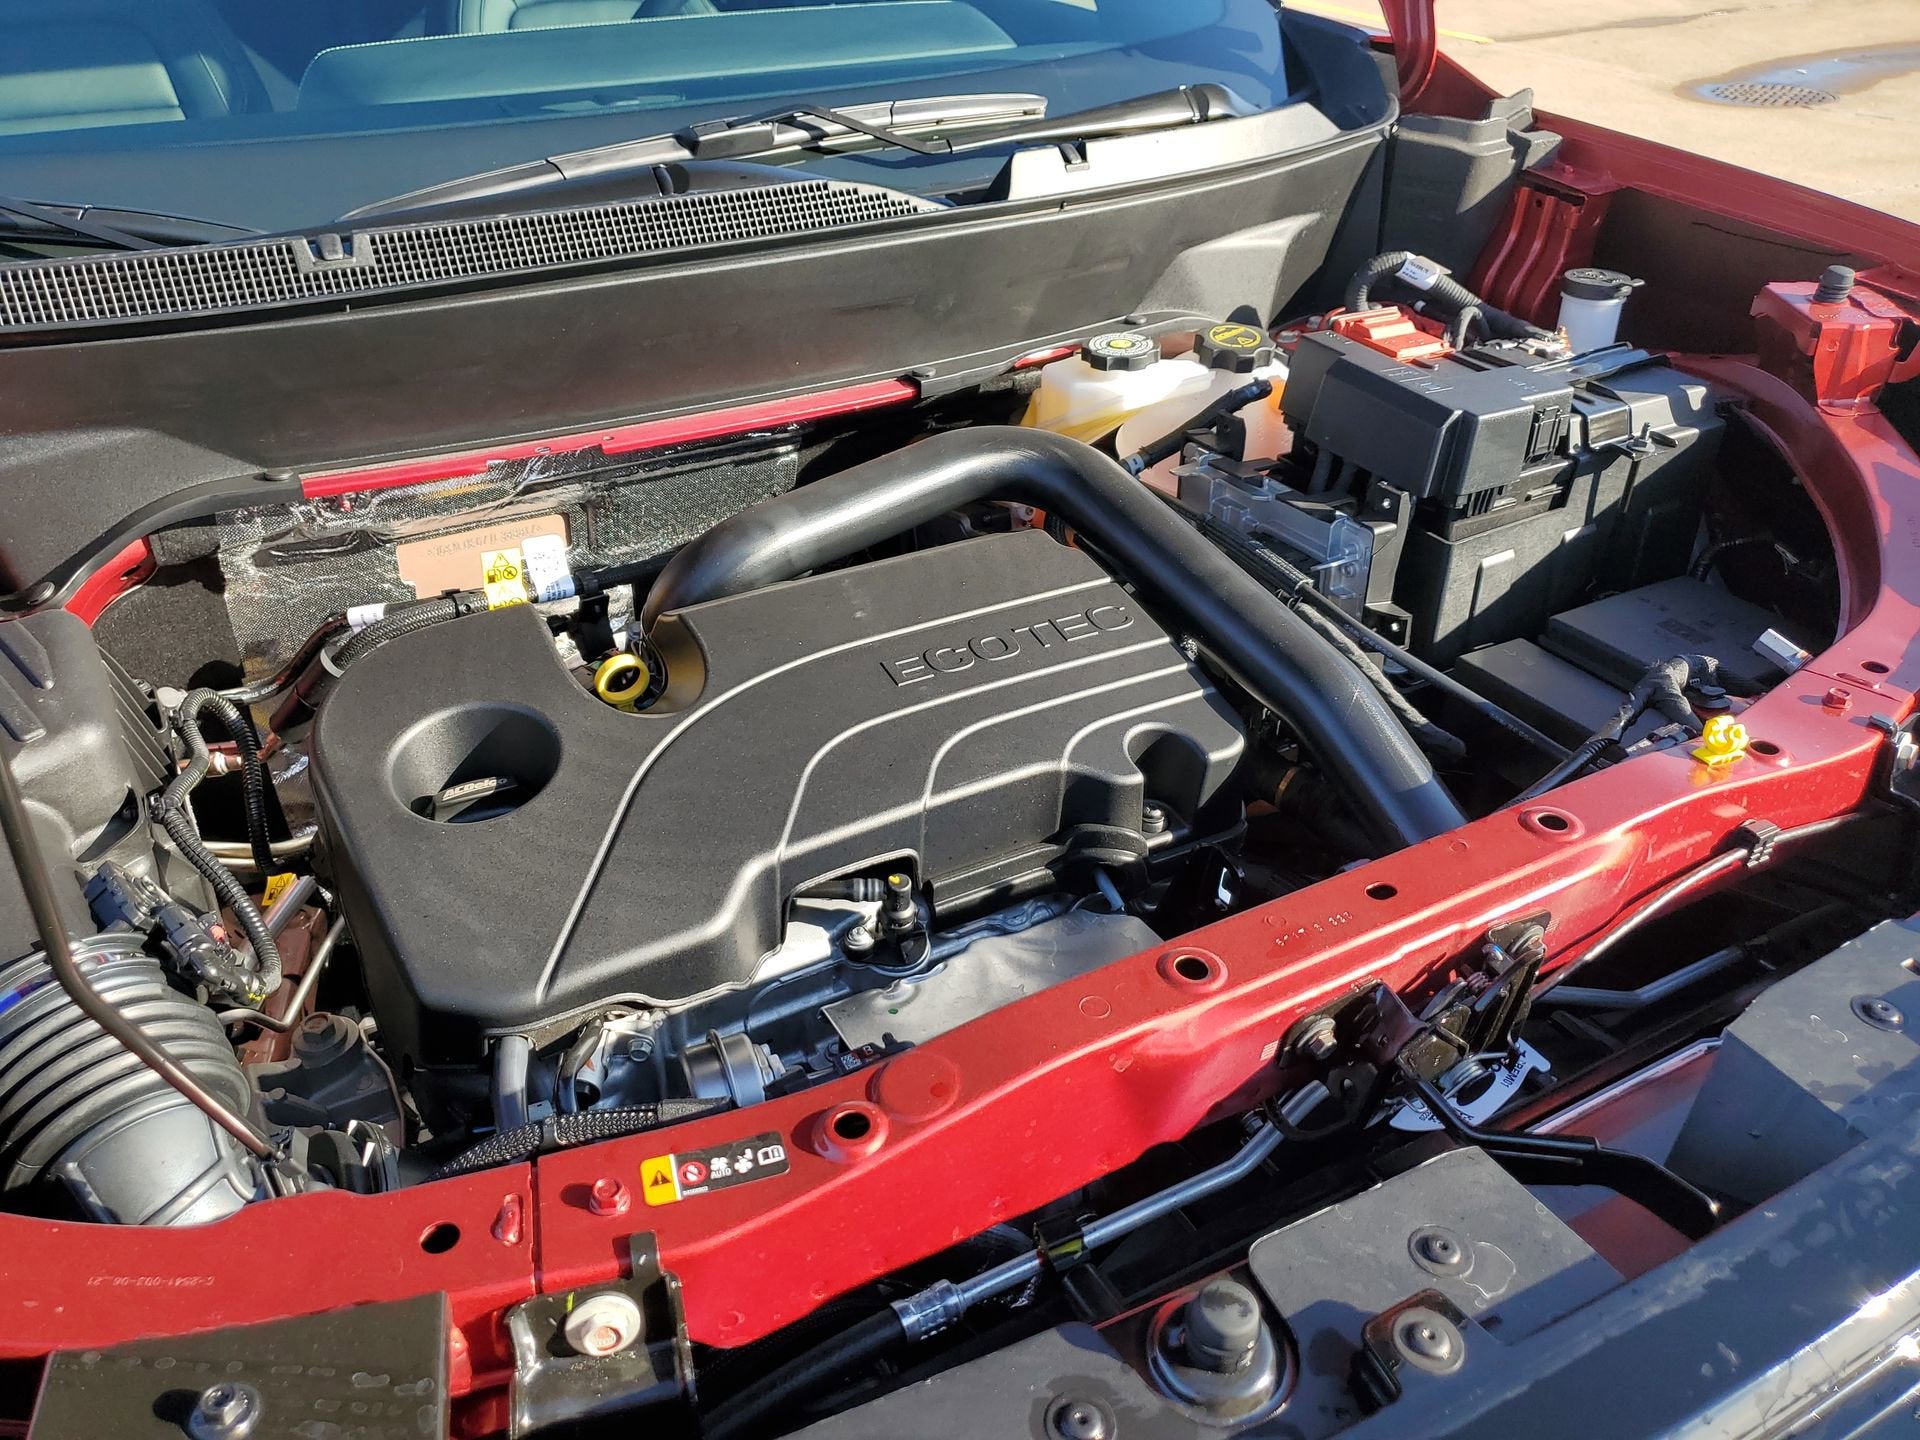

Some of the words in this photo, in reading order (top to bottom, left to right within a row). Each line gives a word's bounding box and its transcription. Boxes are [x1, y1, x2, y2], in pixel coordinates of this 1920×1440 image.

[880, 605, 1135, 687] ECOTEC
[442, 777, 508, 800] ACDelco
[710, 1167, 732, 1180] AUTO
